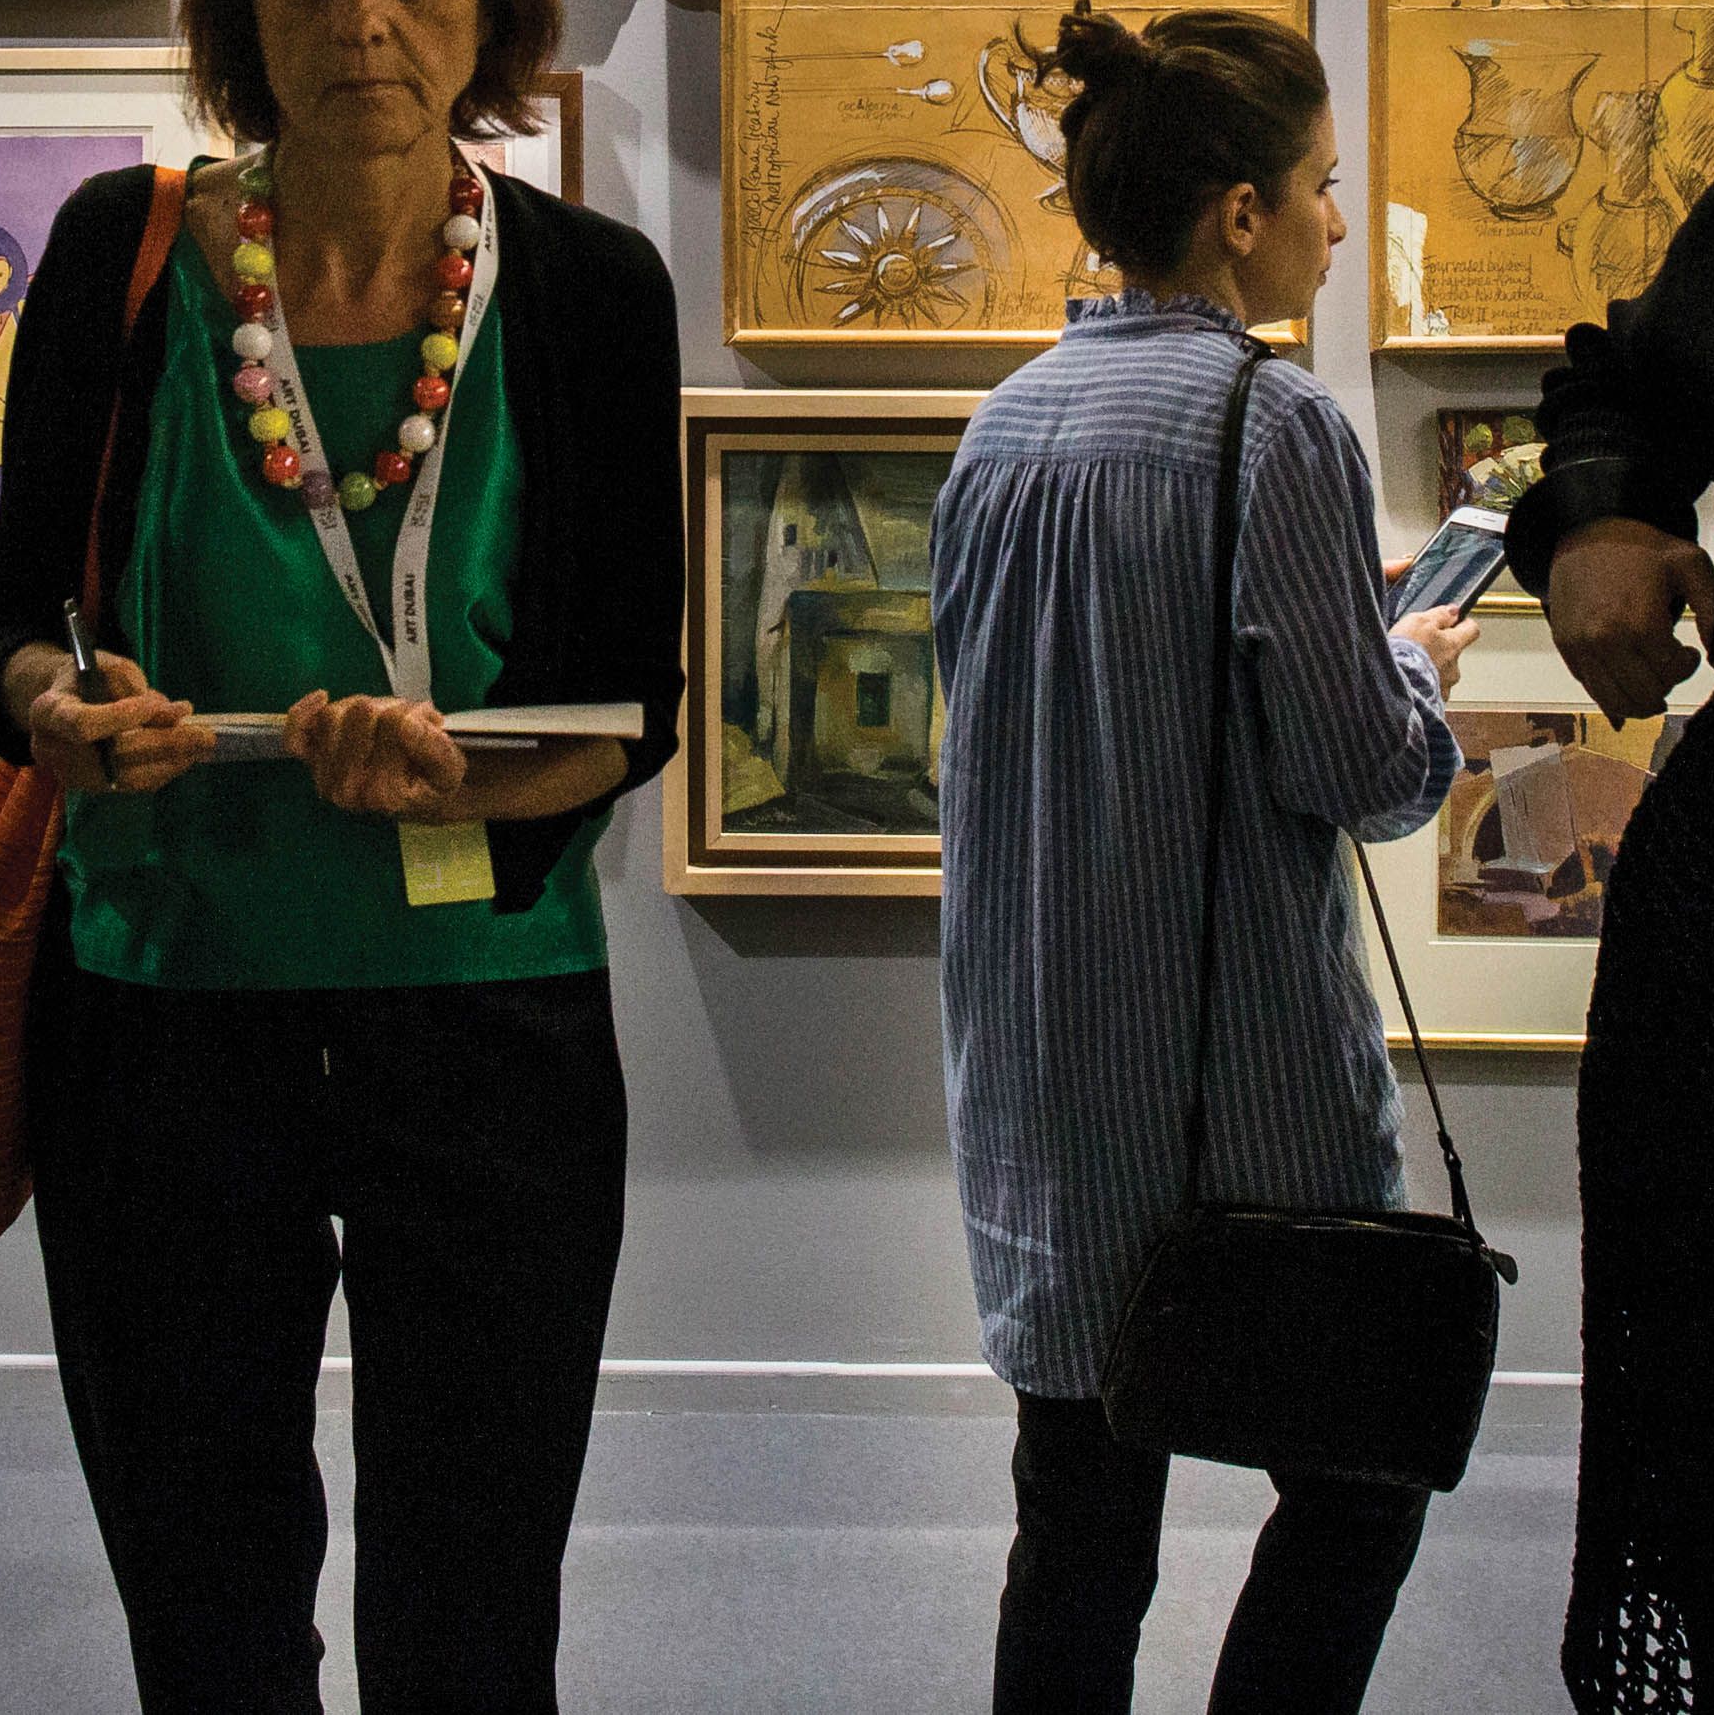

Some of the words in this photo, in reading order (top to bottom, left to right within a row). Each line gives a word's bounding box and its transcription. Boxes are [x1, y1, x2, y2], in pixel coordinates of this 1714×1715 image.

[278, 377, 298, 407] ART
[289, 407, 313, 455] DUBAI
[403, 572, 417, 617] DUBAI
[405, 618, 421, 645] ART
